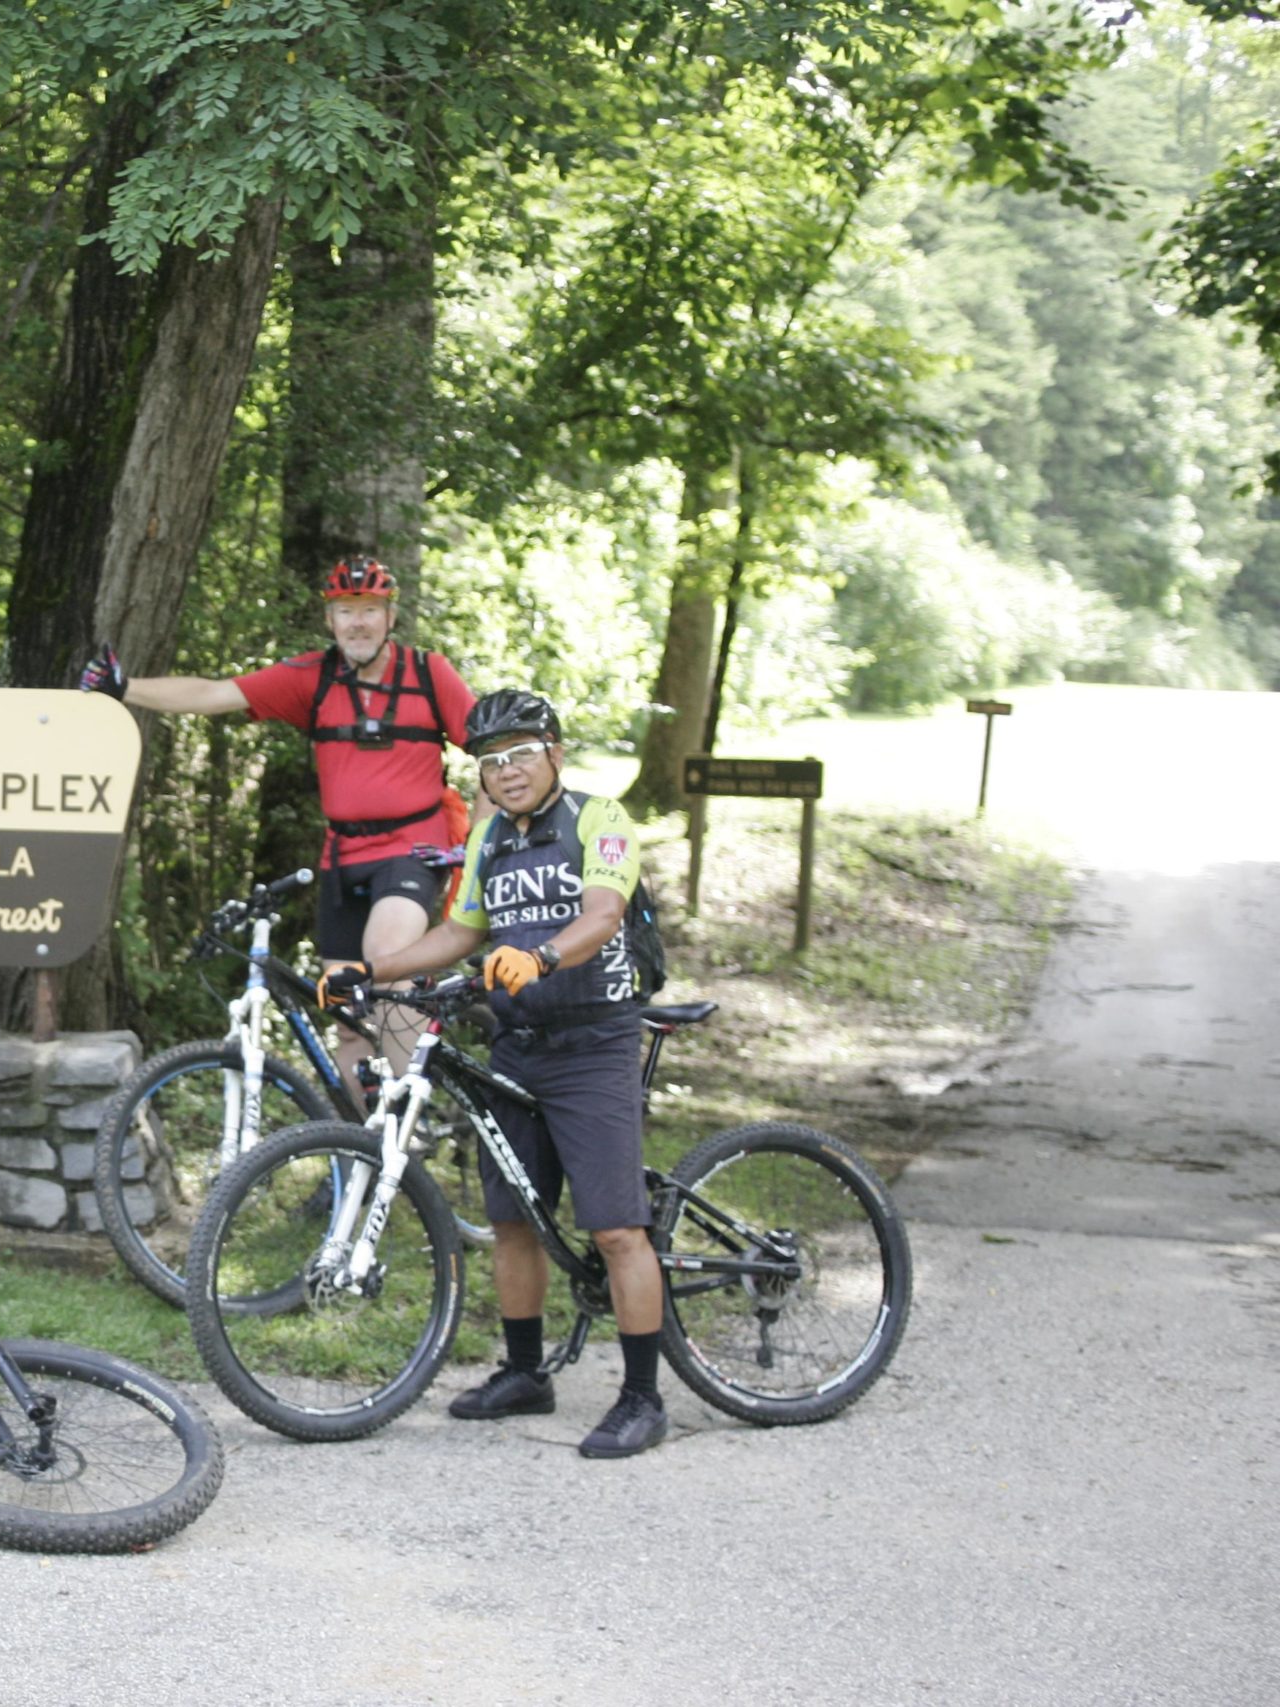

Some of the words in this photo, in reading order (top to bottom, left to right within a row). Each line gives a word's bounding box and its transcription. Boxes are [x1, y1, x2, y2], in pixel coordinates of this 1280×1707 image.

[601, 917, 633, 1002] EN'S
[483, 1108, 541, 1202] TREK
[363, 1199, 388, 1245] FOX
